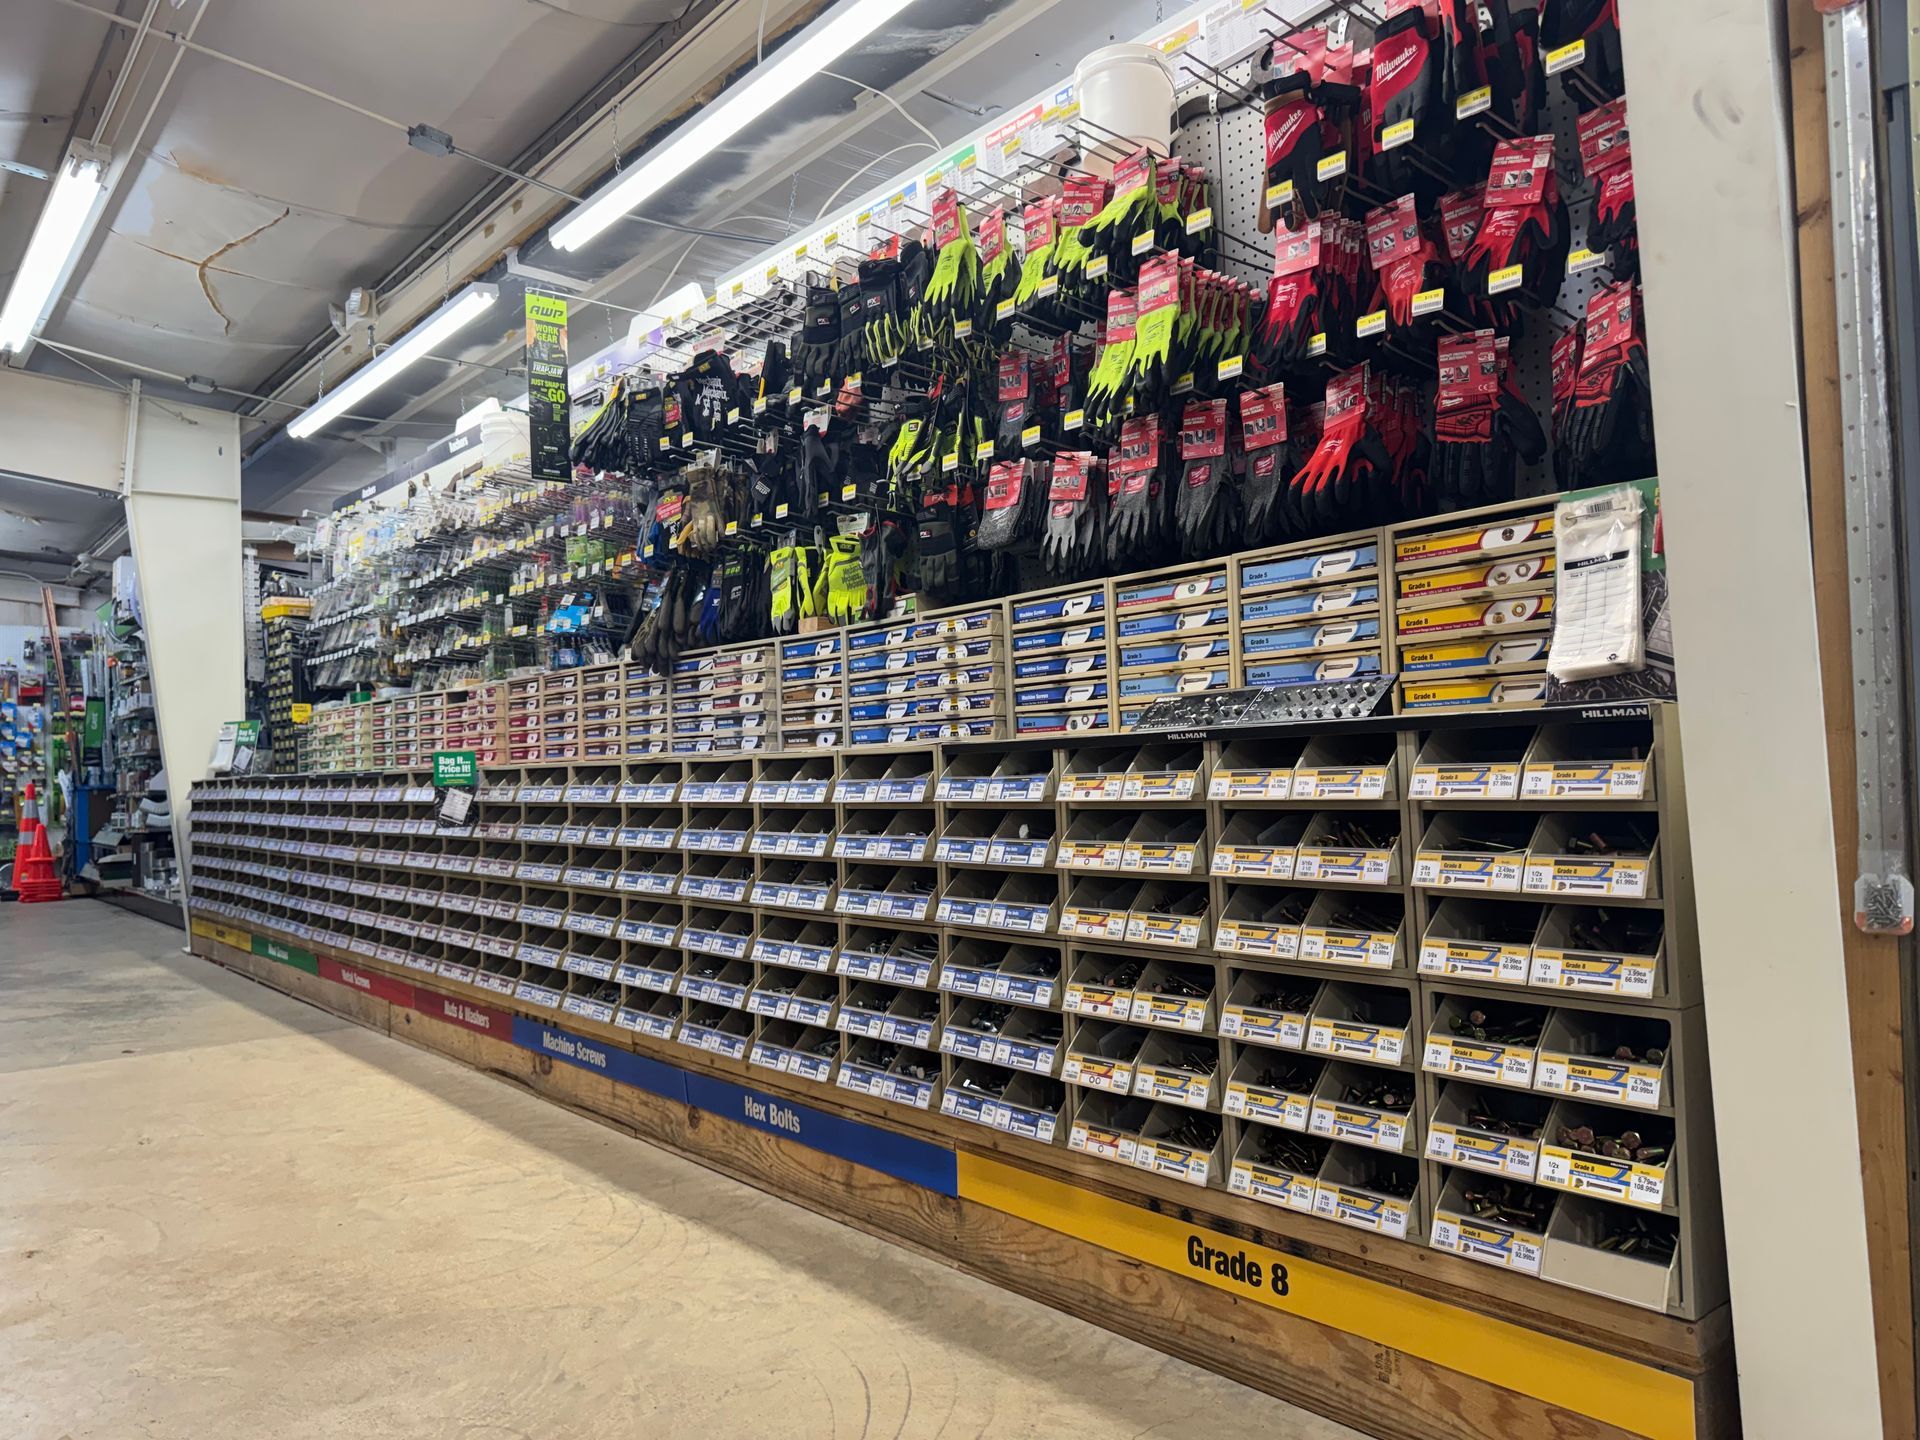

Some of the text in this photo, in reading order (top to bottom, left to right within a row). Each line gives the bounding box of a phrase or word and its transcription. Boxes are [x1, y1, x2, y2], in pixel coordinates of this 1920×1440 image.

[1375, 44, 1418, 81] Milwaukee
[1267, 109, 1303, 150] Milwaukee
[529, 305, 564, 319] AWP
[535, 323, 559, 335] WORK
[536, 333, 558, 344] GEAR
[531, 378, 544, 386] JUST
[548, 388, 566, 404] GO
[1403, 546, 1422, 554] Grade
[1408, 582, 1426, 591] Grade
[1405, 619, 1424, 627] Grade
[1582, 707, 1648, 718] HILLMAN
[1167, 732, 1207, 740] HILLMAN
[438, 756, 471, 766] Bag It...
[439, 765, 471, 773] Price It!
[1565, 961, 1580, 969] Grade
[444, 1000, 490, 1029] Nuts & Washers
[543, 1031, 607, 1068] Machine Screws
[1454, 1048, 1469, 1057] Grade
[1571, 1067, 1587, 1076] Grade
[744, 1095, 801, 1134] Hex Bolts
[1457, 1138, 1473, 1146] Grade
[1548, 1161, 1560, 1169] 1/2x
[1573, 1162, 1591, 1172] Grade
[1462, 1228, 1477, 1237] Grade
[1187, 1235, 1289, 1297] Grade 8
